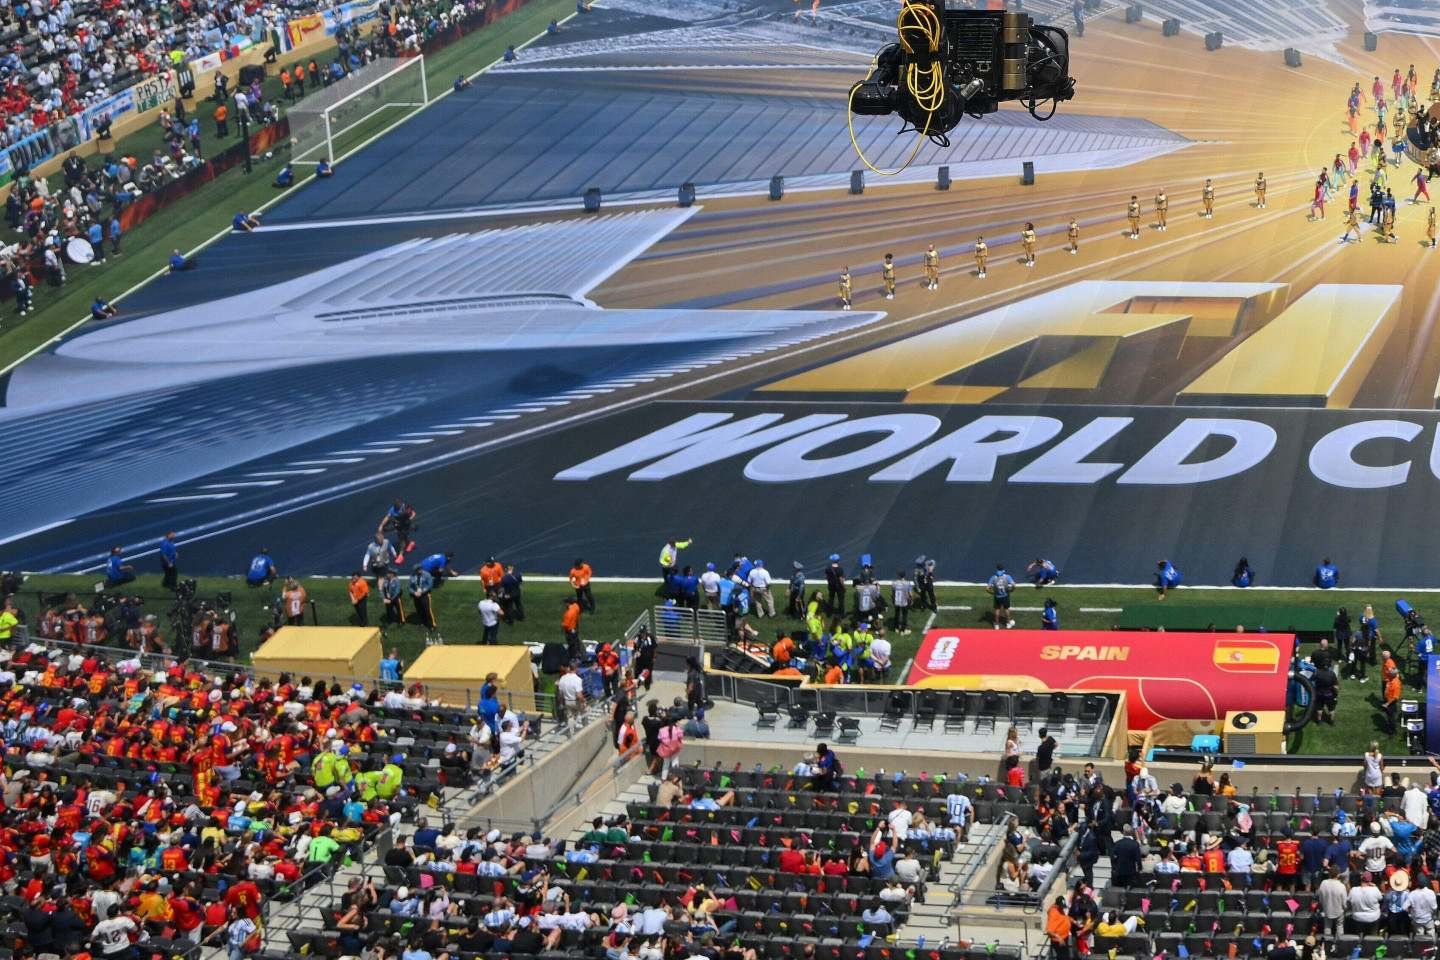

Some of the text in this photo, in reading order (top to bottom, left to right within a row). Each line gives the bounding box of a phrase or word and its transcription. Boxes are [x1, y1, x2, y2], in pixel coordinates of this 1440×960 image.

[553, 411, 1278, 486] WORLD
[1039, 645, 1130, 662] SPAIN
[88, 798, 100, 813] 16
